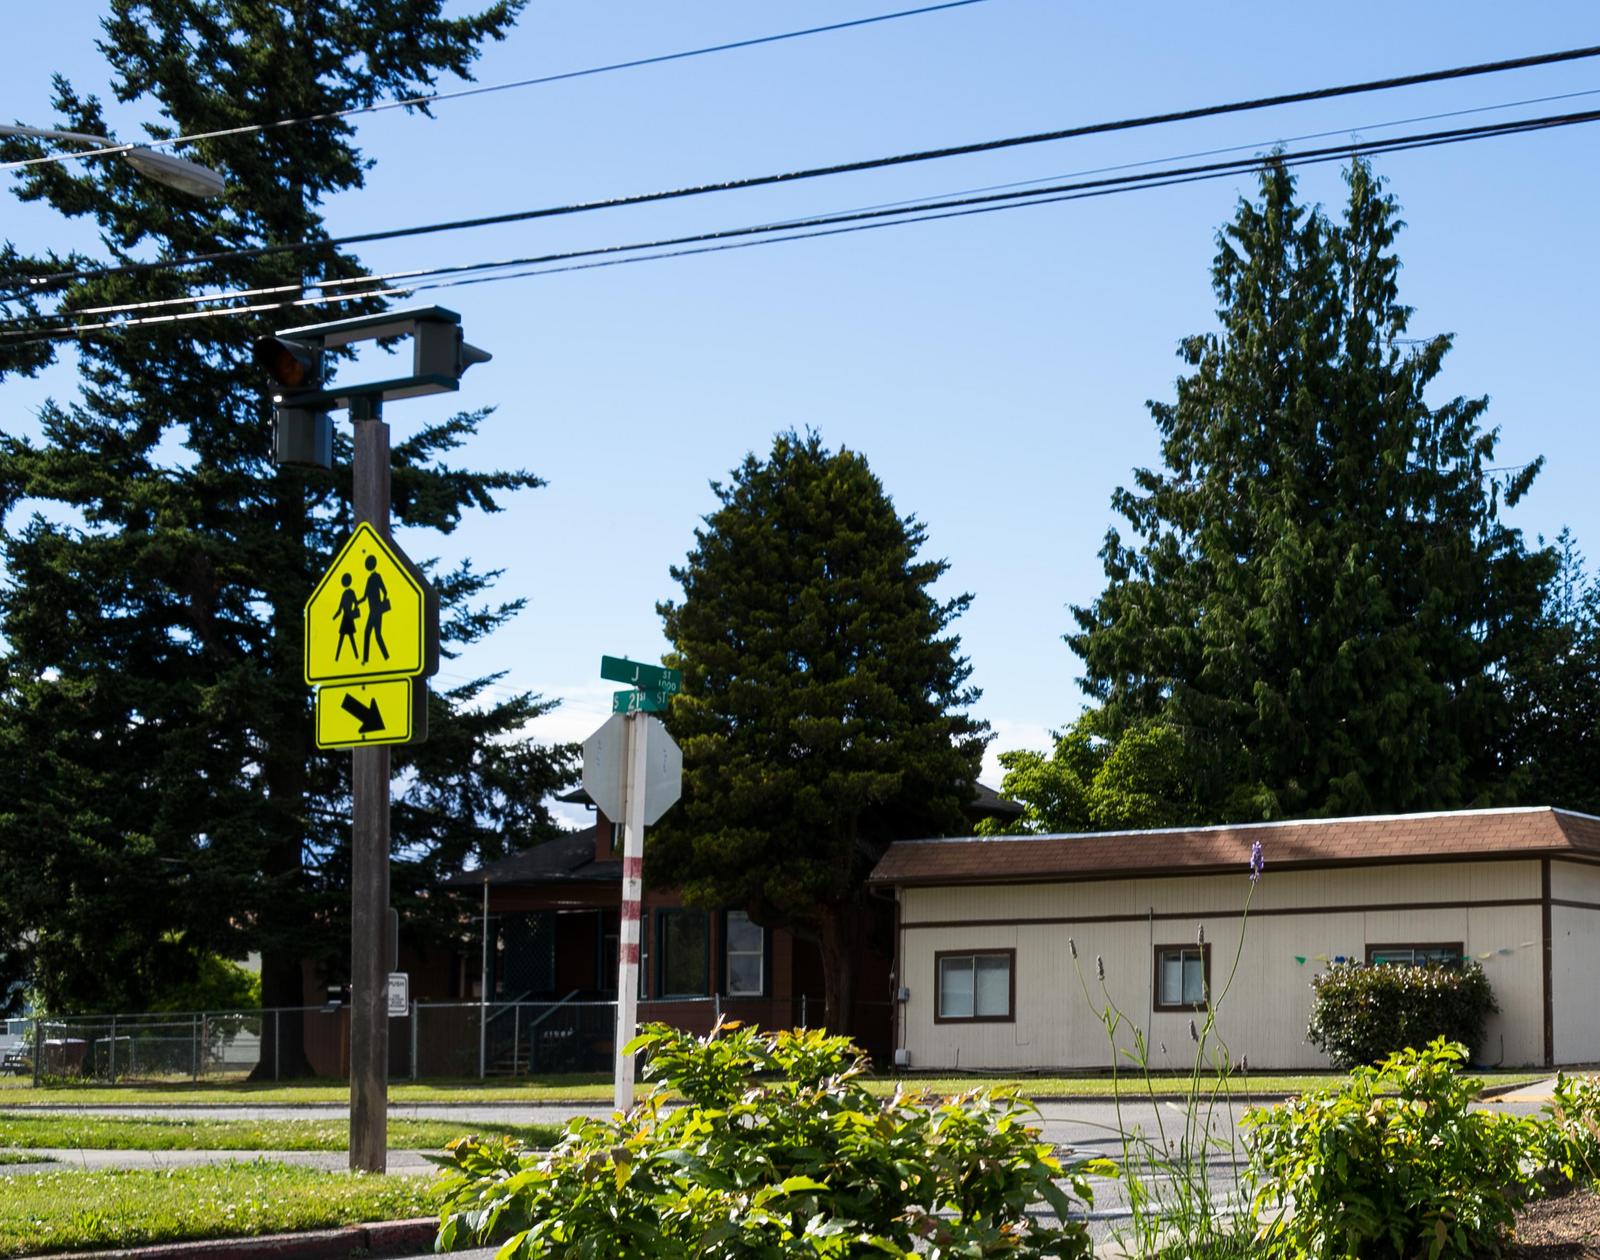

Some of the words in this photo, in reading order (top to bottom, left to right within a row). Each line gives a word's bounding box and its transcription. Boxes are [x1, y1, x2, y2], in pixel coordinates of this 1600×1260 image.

[632, 666, 639, 681] J
[663, 670, 671, 679] ST
[614, 695, 619, 709] S
[656, 691, 667, 704] ST
